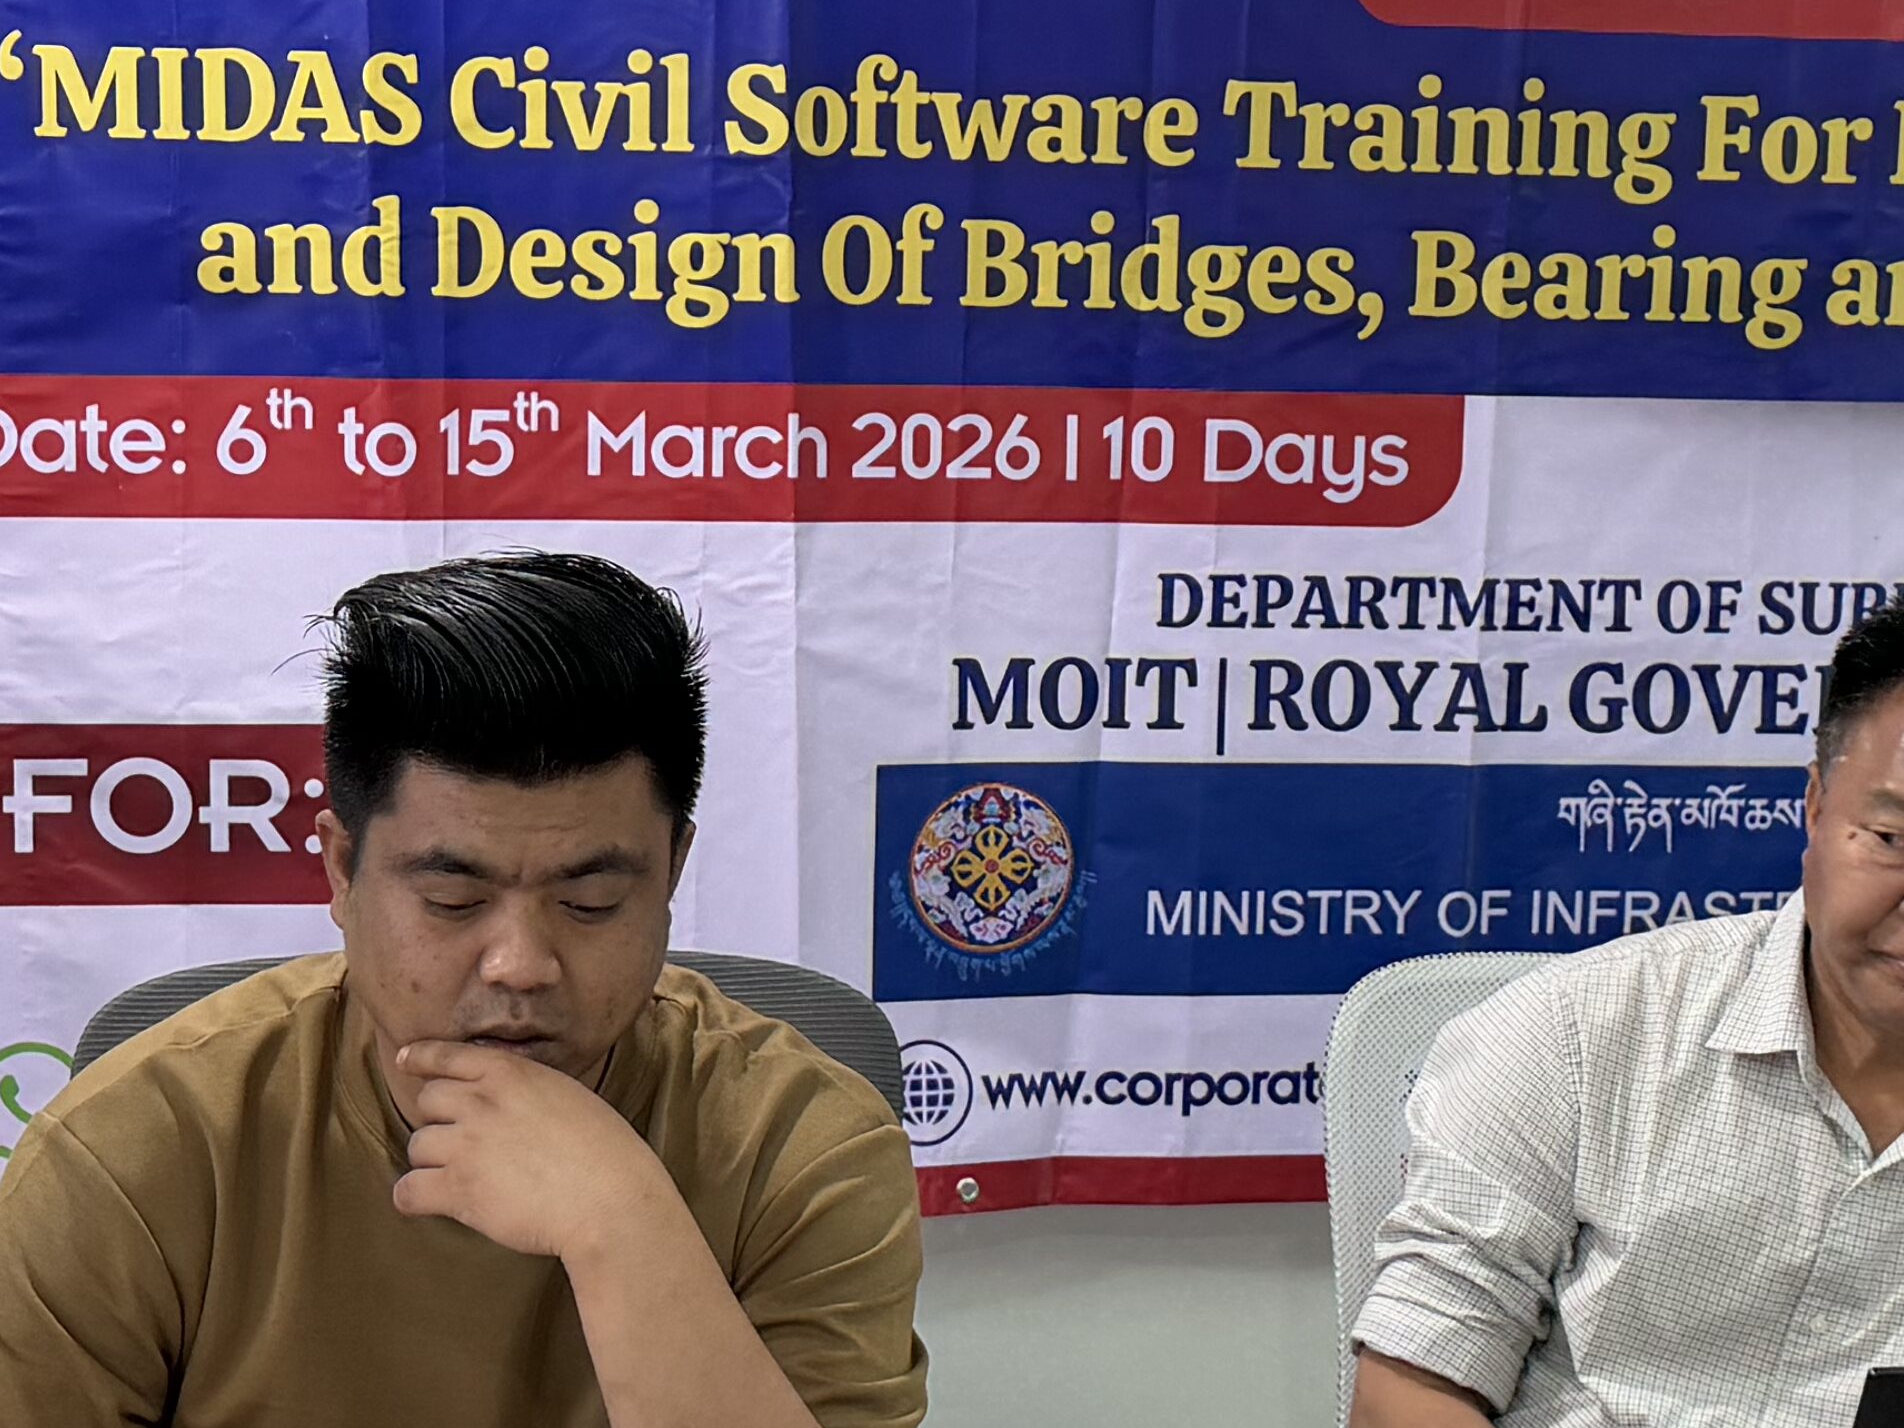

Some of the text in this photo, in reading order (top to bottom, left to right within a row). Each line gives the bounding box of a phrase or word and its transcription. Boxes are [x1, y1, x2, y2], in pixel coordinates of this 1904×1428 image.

[449, 46, 696, 154] Civil
[725, 53, 1198, 172] Software
[1222, 74, 1676, 206] Training
[1696, 92, 1873, 186] For
[197, 195, 400, 300] and
[429, 198, 800, 329] Design
[822, 204, 944, 307] Of
[959, 210, 1385, 342] Bridges,
[1408, 226, 1810, 349] Bearing
[339, 410, 417, 477] to
[585, 413, 830, 481] March
[850, 412, 1041, 483] 2026
[1102, 415, 1177, 483] 10
[1203, 416, 1409, 504] Days
[1156, 571, 1642, 633] DEPARTMENT
[1655, 578, 1742, 636] OF
[951, 656, 1198, 732] MOIT
[1246, 658, 1550, 737] ROYAL
[1, 756, 326, 857] FOR:
[1146, 889, 1424, 938] MINISTRY
[1434, 889, 1511, 939] OF
